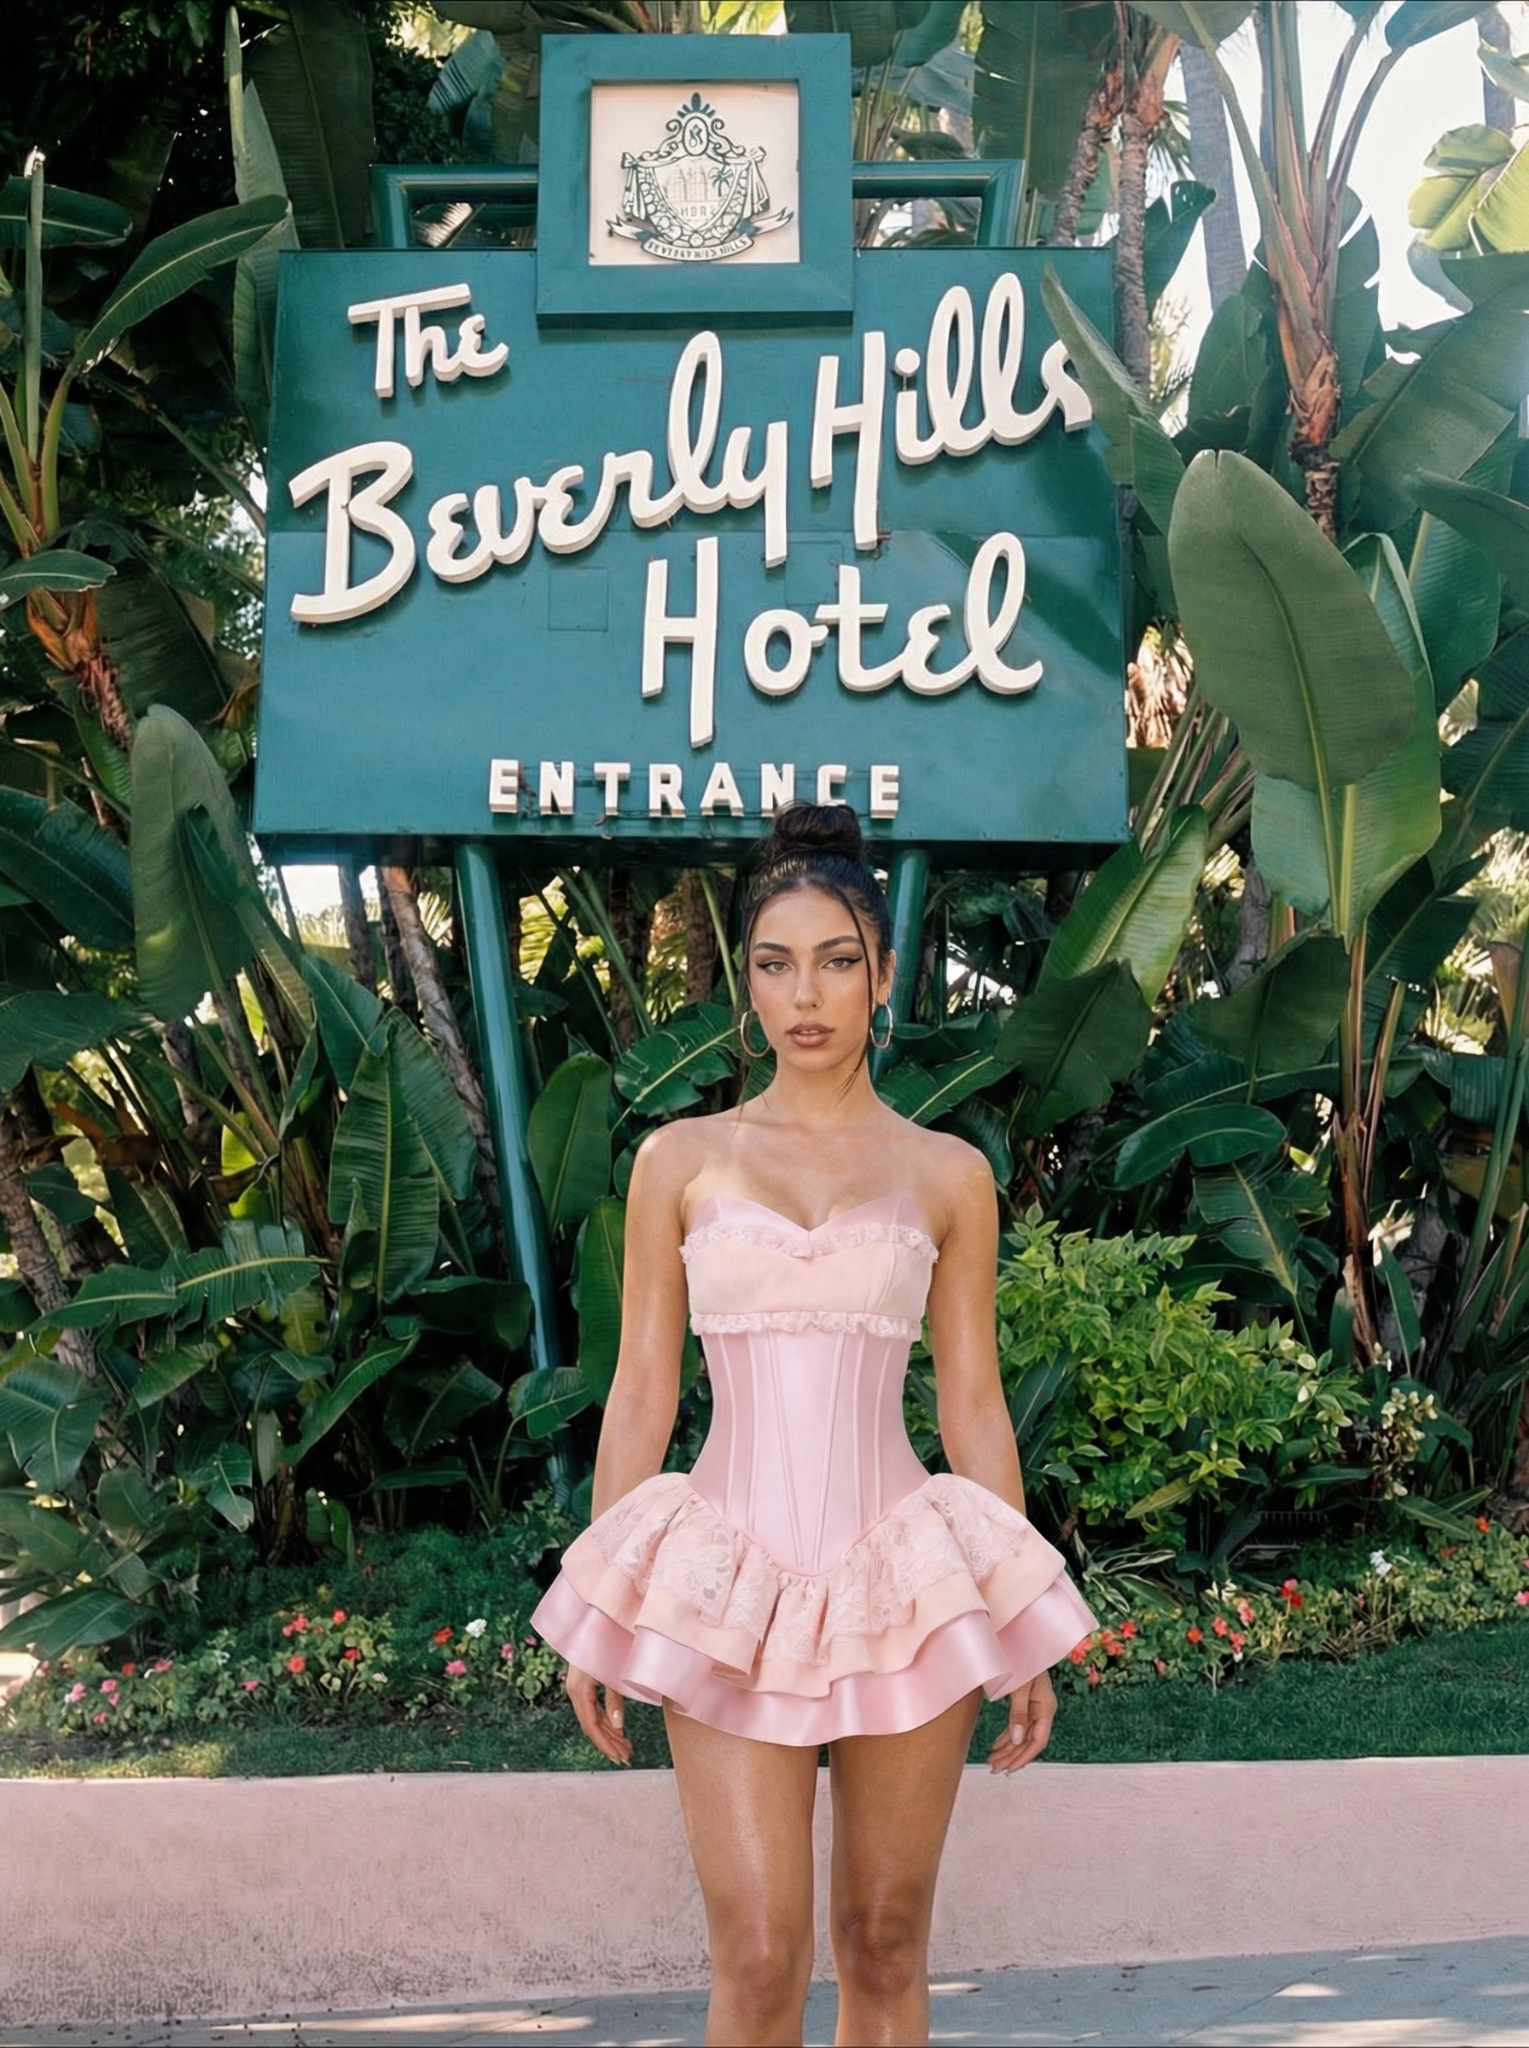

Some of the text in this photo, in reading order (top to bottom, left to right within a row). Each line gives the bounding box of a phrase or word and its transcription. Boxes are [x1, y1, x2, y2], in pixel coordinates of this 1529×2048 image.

[348, 283, 509, 399] The
[288, 272, 1093, 624] Beverly Hills
[641, 532, 1044, 749] Hotel
[488, 758, 900, 820] ENTRANCE
